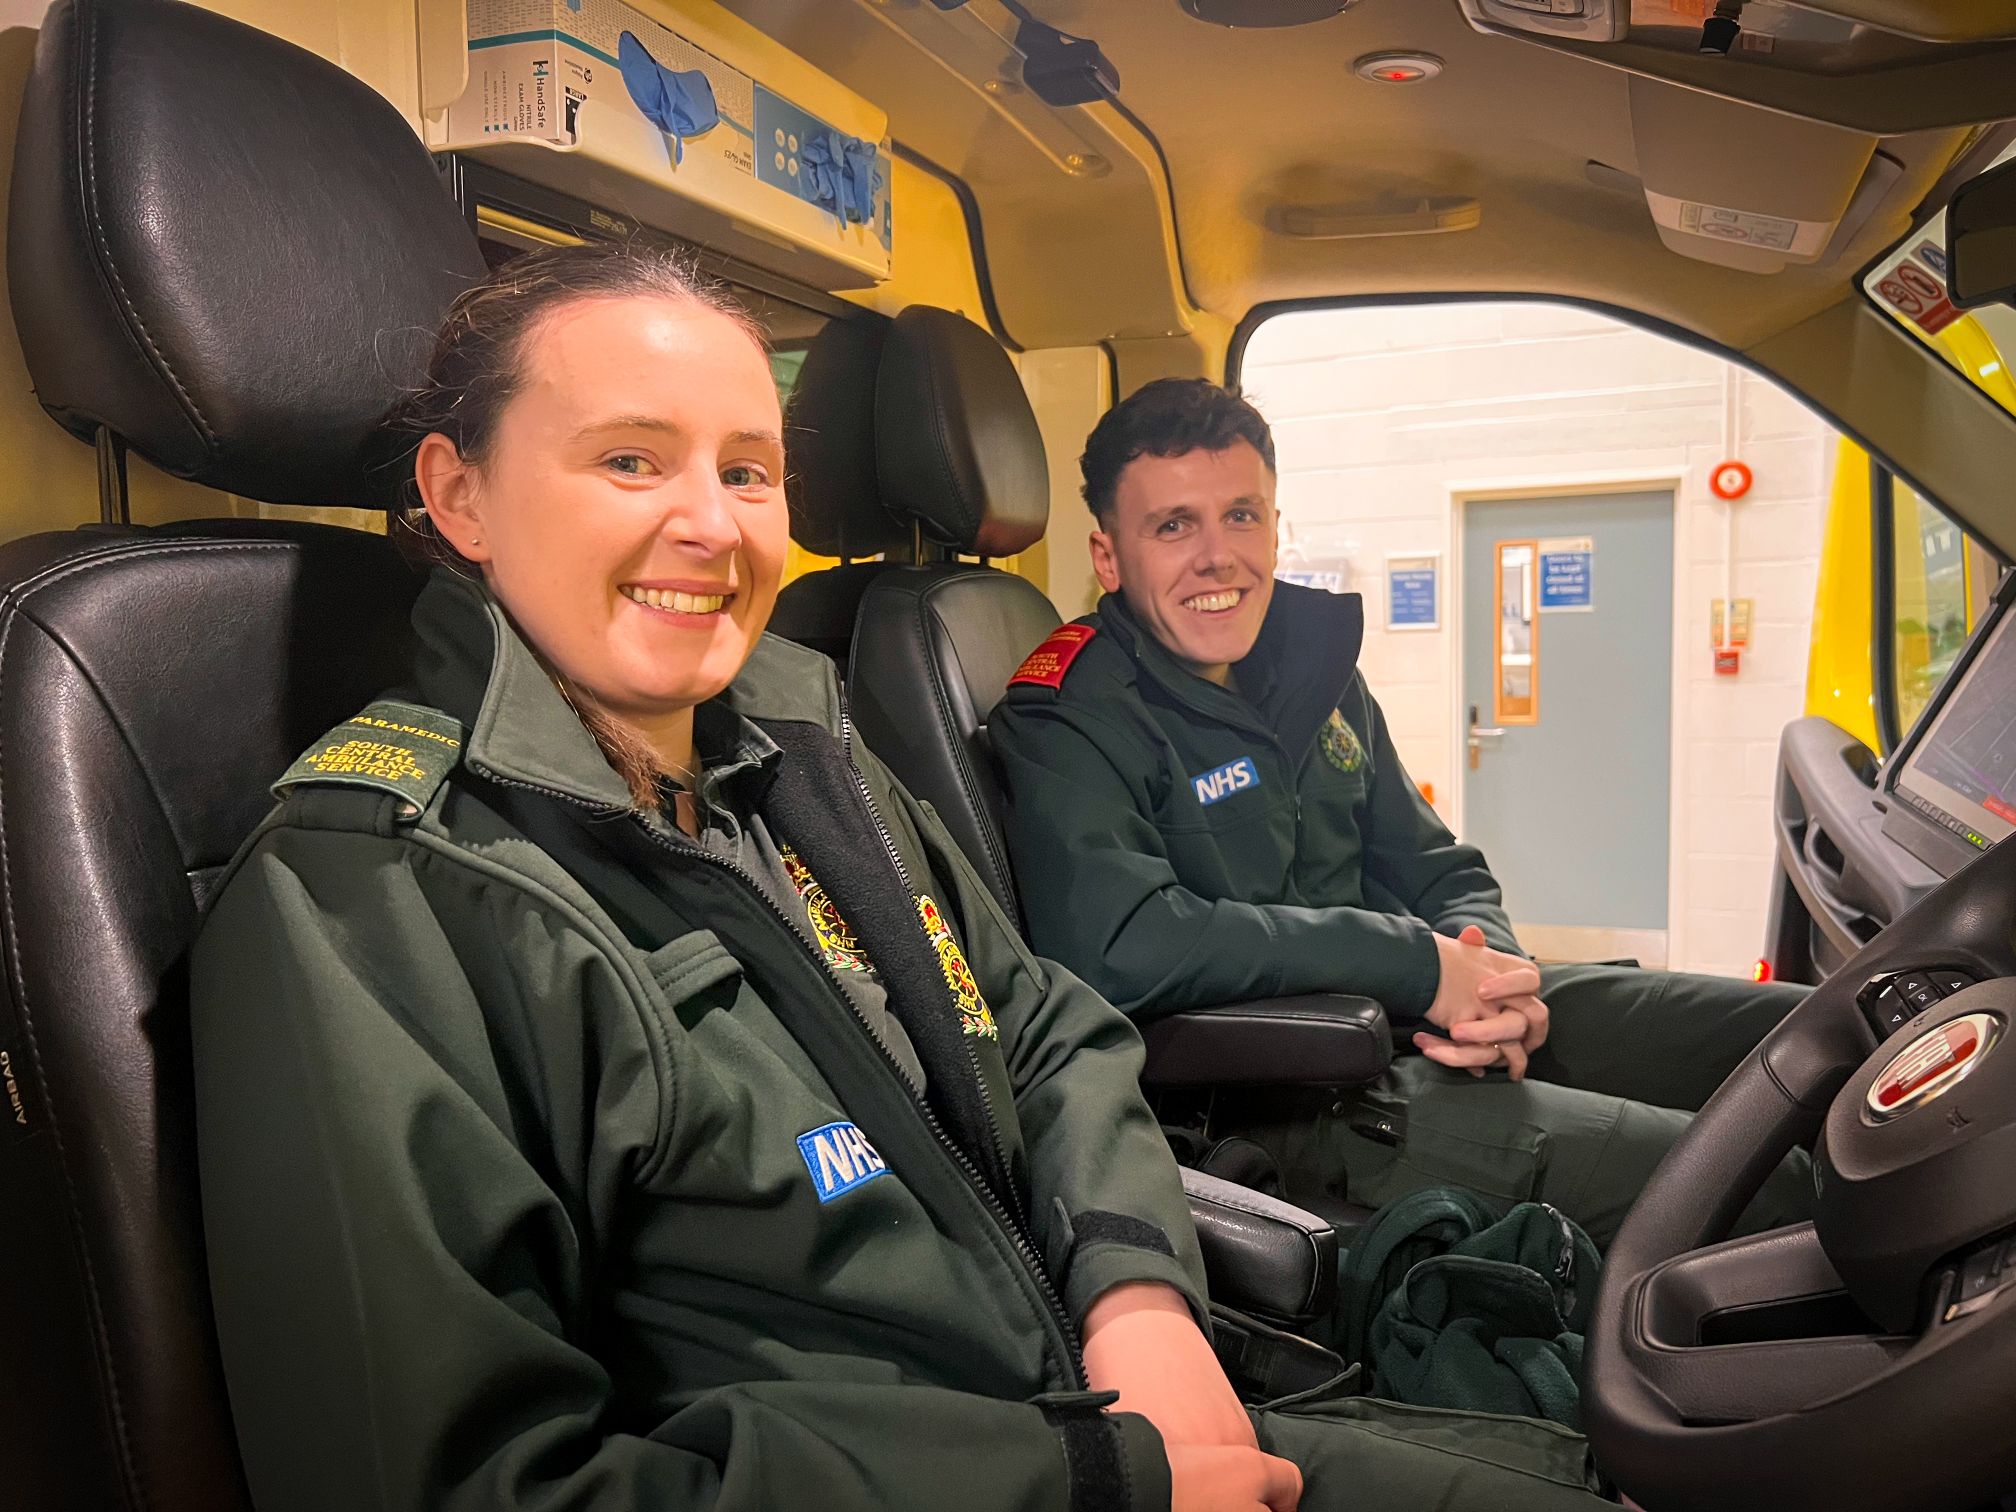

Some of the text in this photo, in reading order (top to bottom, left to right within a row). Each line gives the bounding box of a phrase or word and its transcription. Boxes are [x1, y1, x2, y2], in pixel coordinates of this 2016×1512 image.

[536, 78, 547, 128] HandSafe
[349, 716, 461, 748] PARAMEDIC
[325, 746, 416, 767] CENTRAL
[344, 740, 413, 757] SOUTH
[305, 754, 427, 780] AMBULANCE
[314, 762, 403, 781] SERVICE
[1195, 761, 1251, 803] NHS
[0, 1051, 27, 1124] AIRBAG
[814, 1127, 886, 1192] NHS
